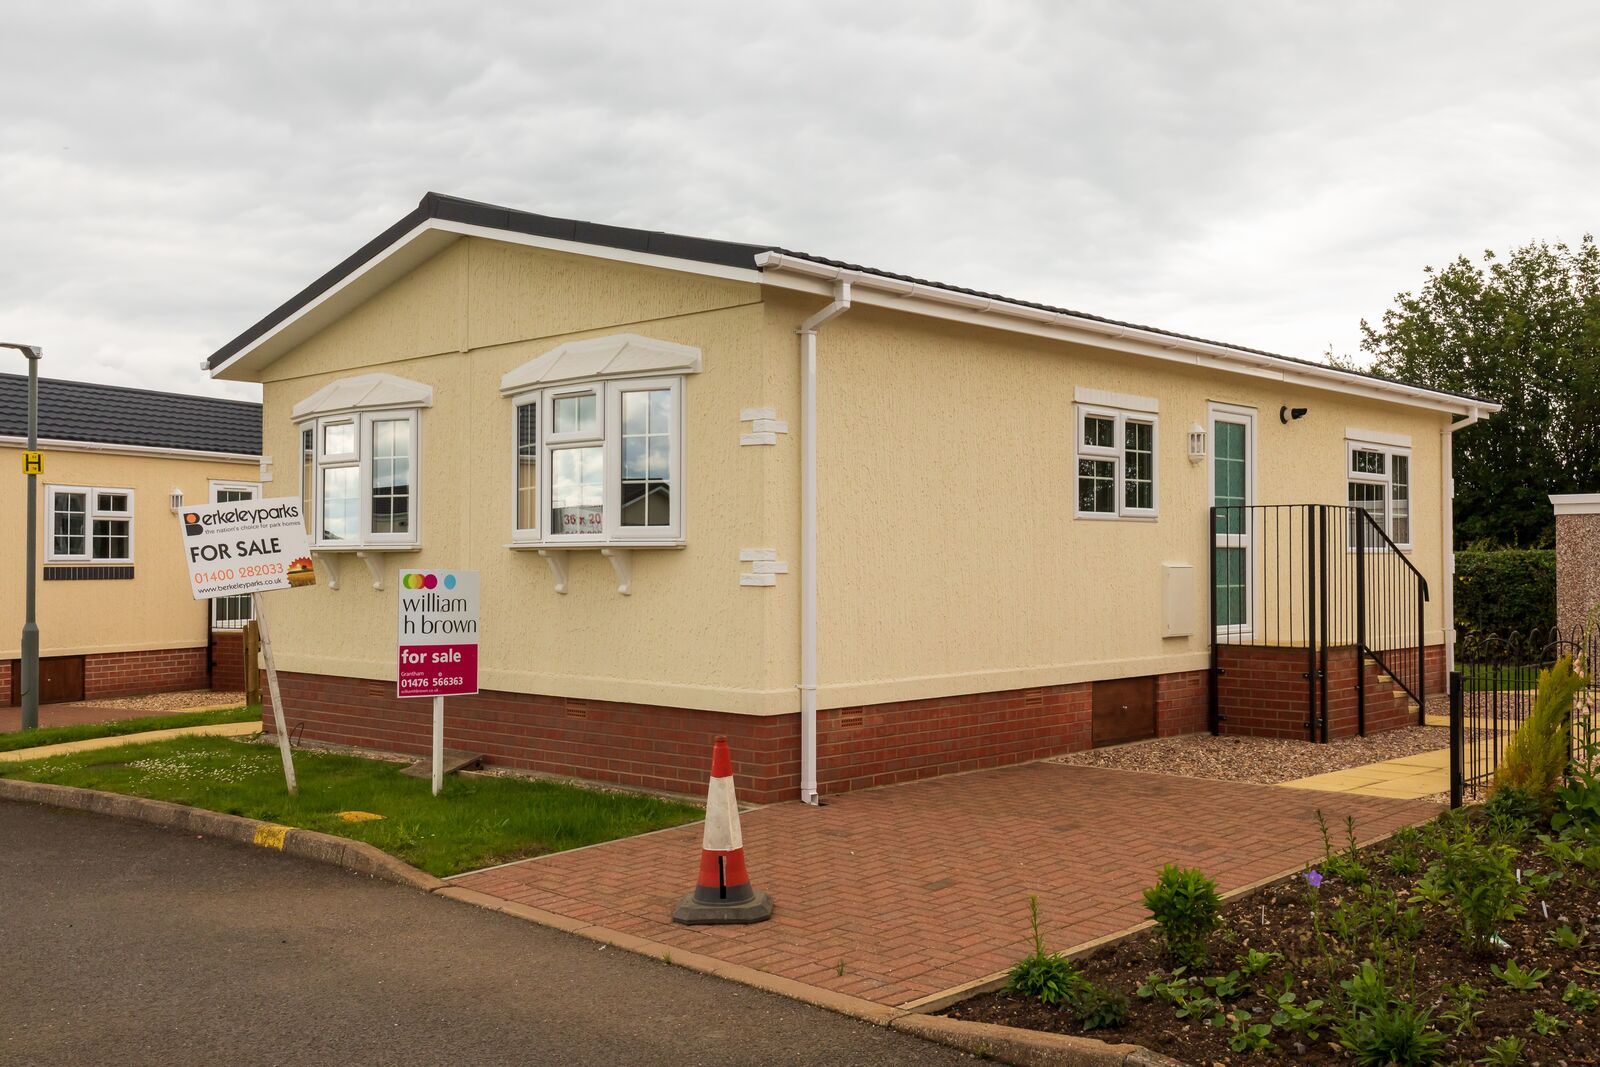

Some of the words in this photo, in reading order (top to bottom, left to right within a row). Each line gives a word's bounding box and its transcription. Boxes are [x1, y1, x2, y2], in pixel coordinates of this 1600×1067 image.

[26, 454, 41, 471] H
[183, 504, 299, 536] Berkeleyparks
[240, 523, 259, 531] choice
[269, 521, 281, 529] park
[190, 544, 232, 563] FOR
[236, 538, 281, 557] SALE
[194, 568, 235, 584] 01400
[239, 563, 284, 578] 282033
[198, 577, 282, 594] www.berkeleyparks.co.uk
[402, 593, 467, 612] william
[404, 614, 415, 634] h
[421, 614, 477, 634] brown
[401, 649, 428, 664] for
[431, 648, 462, 663] sale
[401, 678, 429, 688] 01476
[432, 676, 463, 686] 566363
